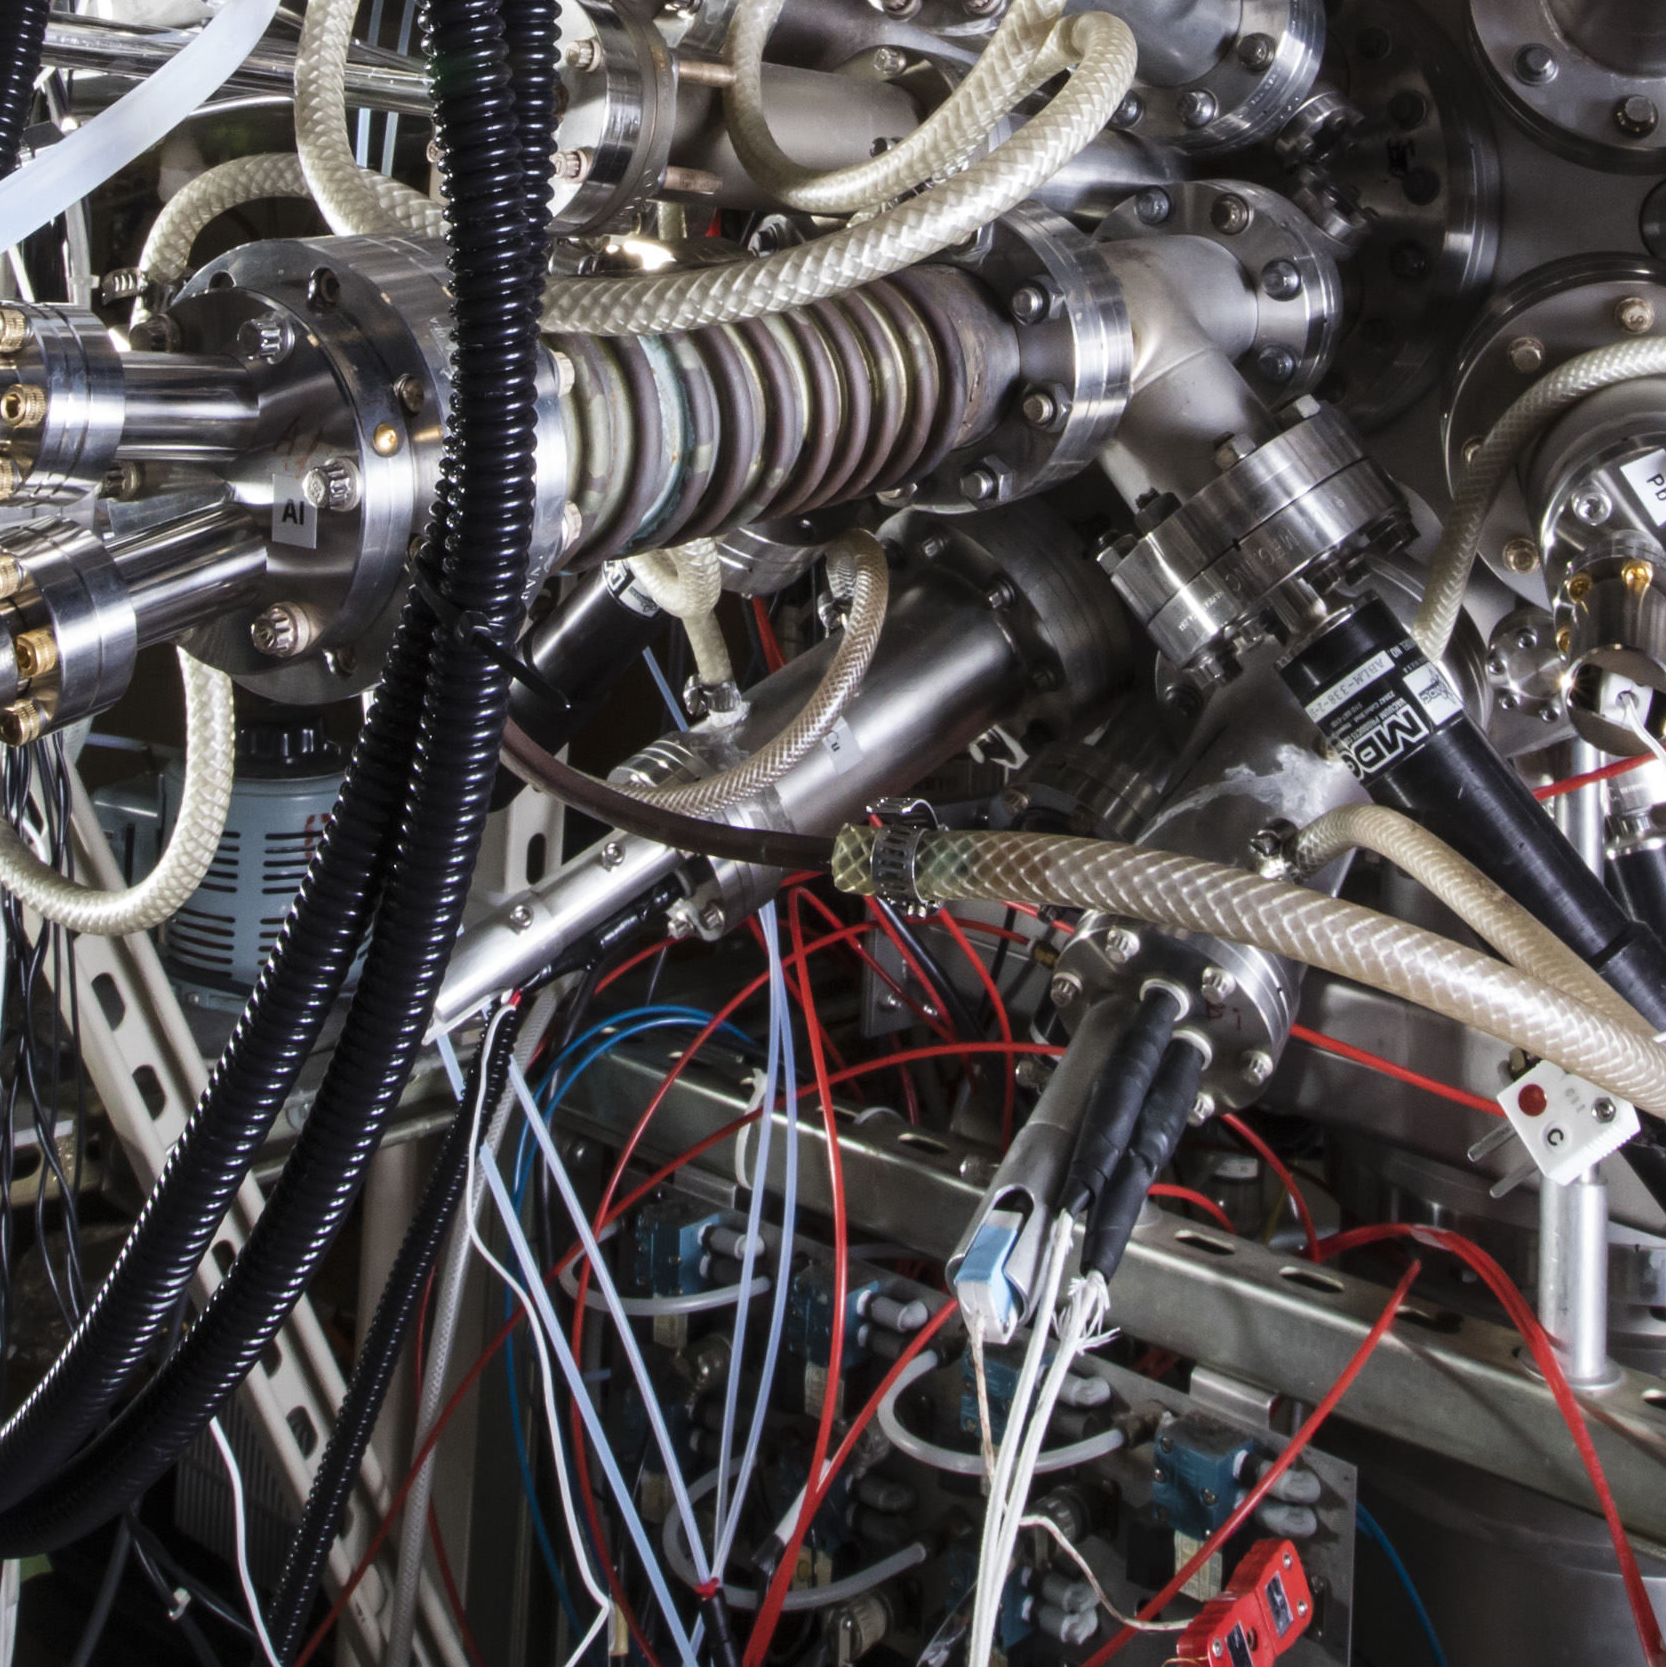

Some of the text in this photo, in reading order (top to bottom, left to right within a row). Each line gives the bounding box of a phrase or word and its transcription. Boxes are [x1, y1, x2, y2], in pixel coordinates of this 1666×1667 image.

[280, 501, 305, 527] Al
[1377, 695, 1406, 720] VACUUM
[1543, 1124, 1567, 1149] C
